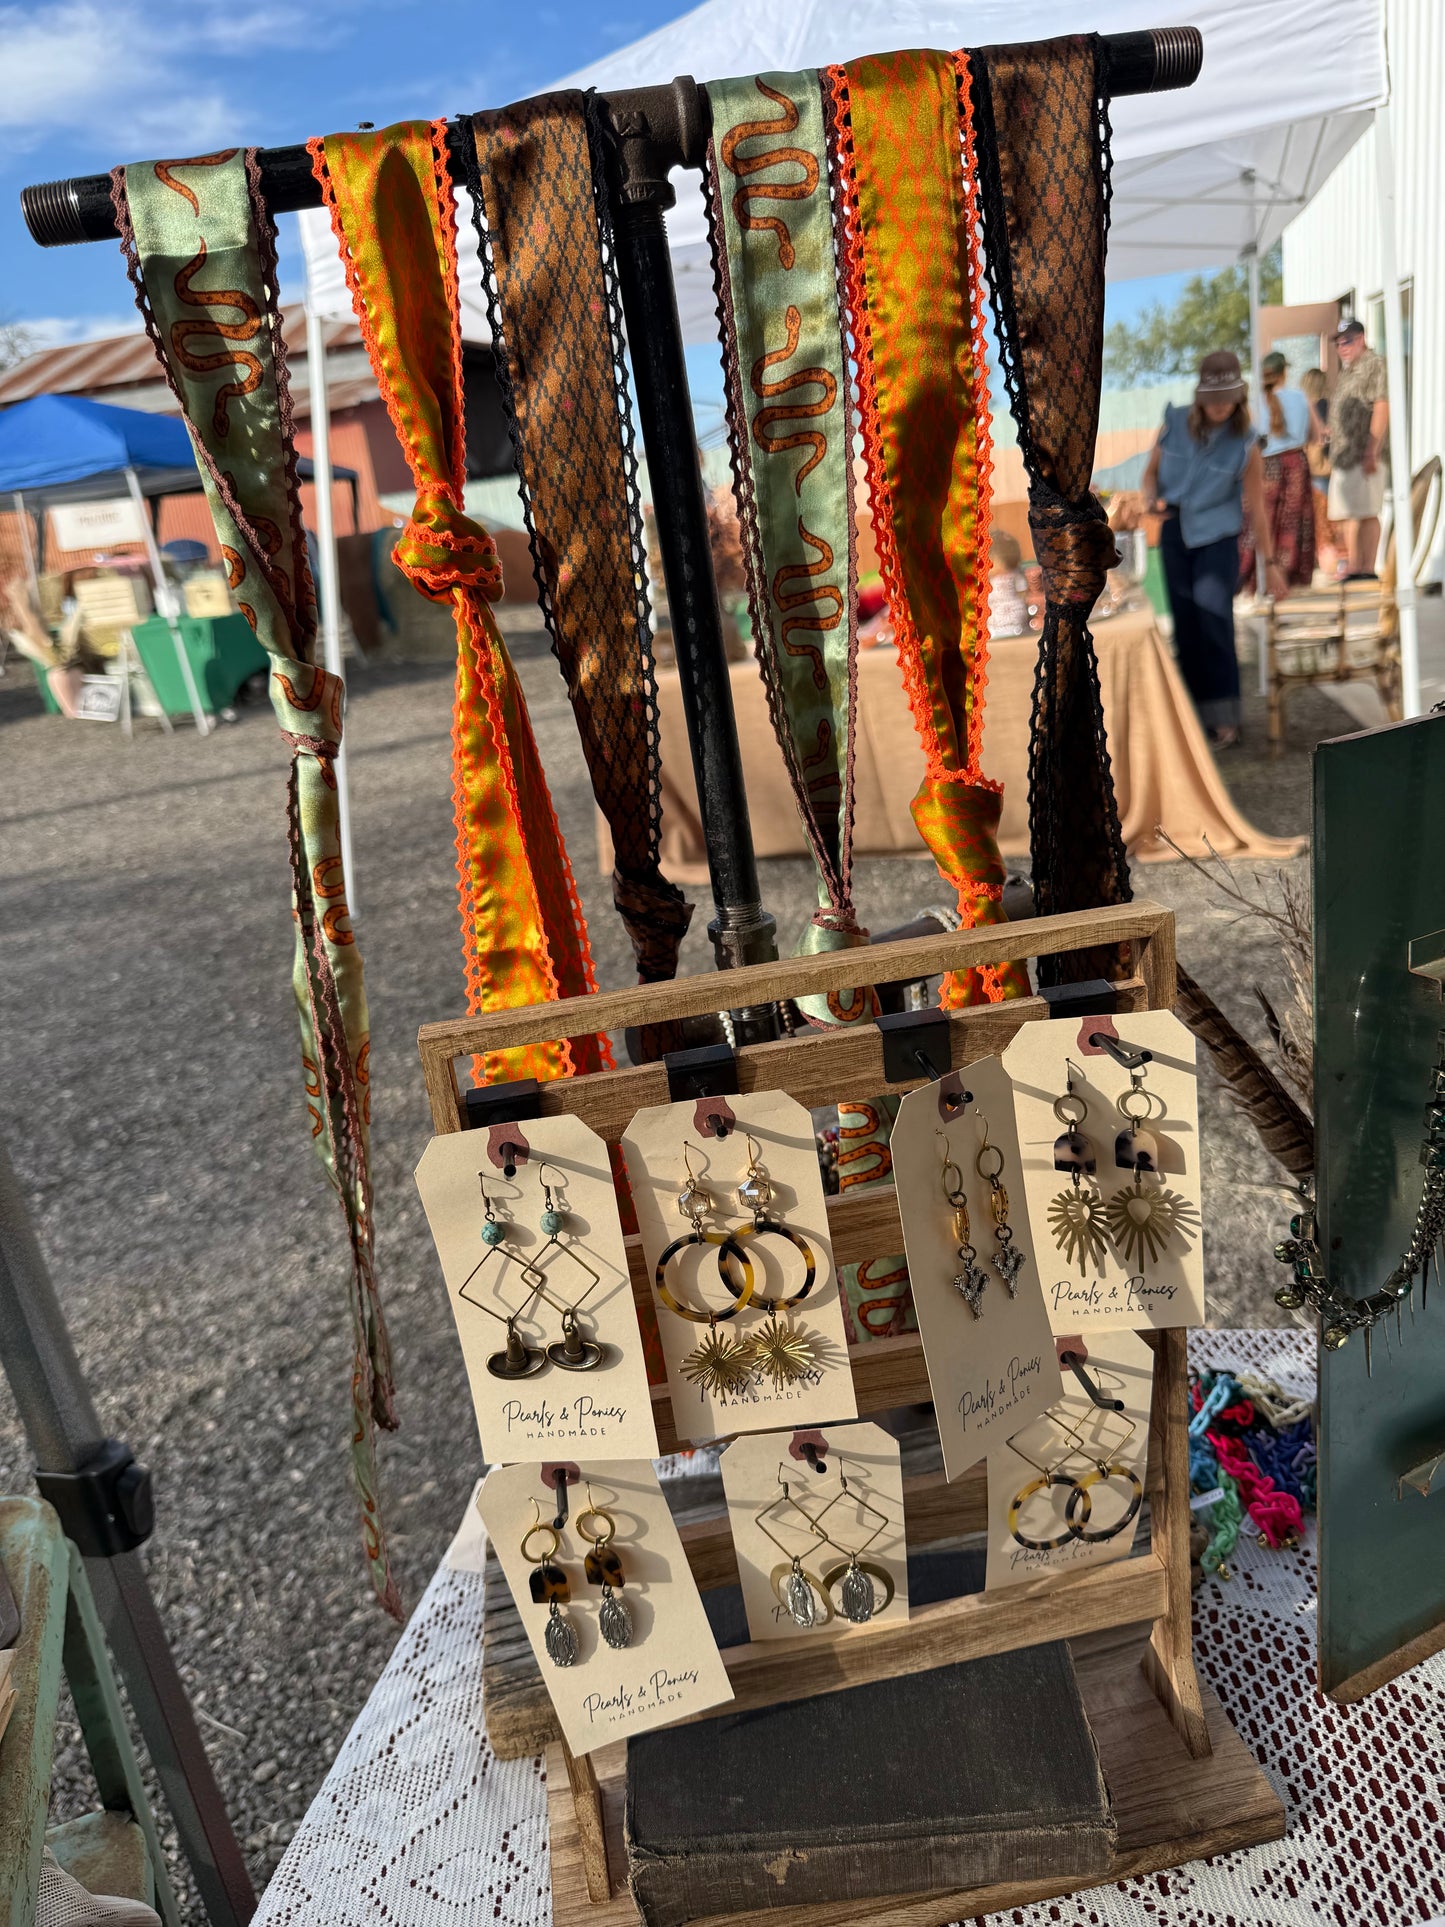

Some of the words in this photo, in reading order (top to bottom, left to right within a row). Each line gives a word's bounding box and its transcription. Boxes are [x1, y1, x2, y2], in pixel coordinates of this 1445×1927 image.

[1051, 1281, 1103, 1310] Pearls
[1108, 1287, 1118, 1299] &
[1125, 1276, 1178, 1306] Ponies
[1073, 1303, 1153, 1316] HANDMADE
[755, 1372, 765, 1386] &
[958, 1378, 996, 1432] Pearls
[999, 1378, 1006, 1395] &
[1007, 1356, 1041, 1397] Ponies
[502, 1400, 555, 1433] Pearls
[559, 1407, 569, 1421] &
[573, 1396, 627, 1429] Ponies
[720, 1391, 802, 1407] HANDMADE
[977, 1385, 1031, 1430] HANDMADE
[526, 1427, 606, 1439] HANDMADE
[583, 1685, 633, 1723] Pearls
[638, 1686, 647, 1698] &
[649, 1669, 699, 1700] Ponies
[608, 1691, 683, 1722] HANDMADE
